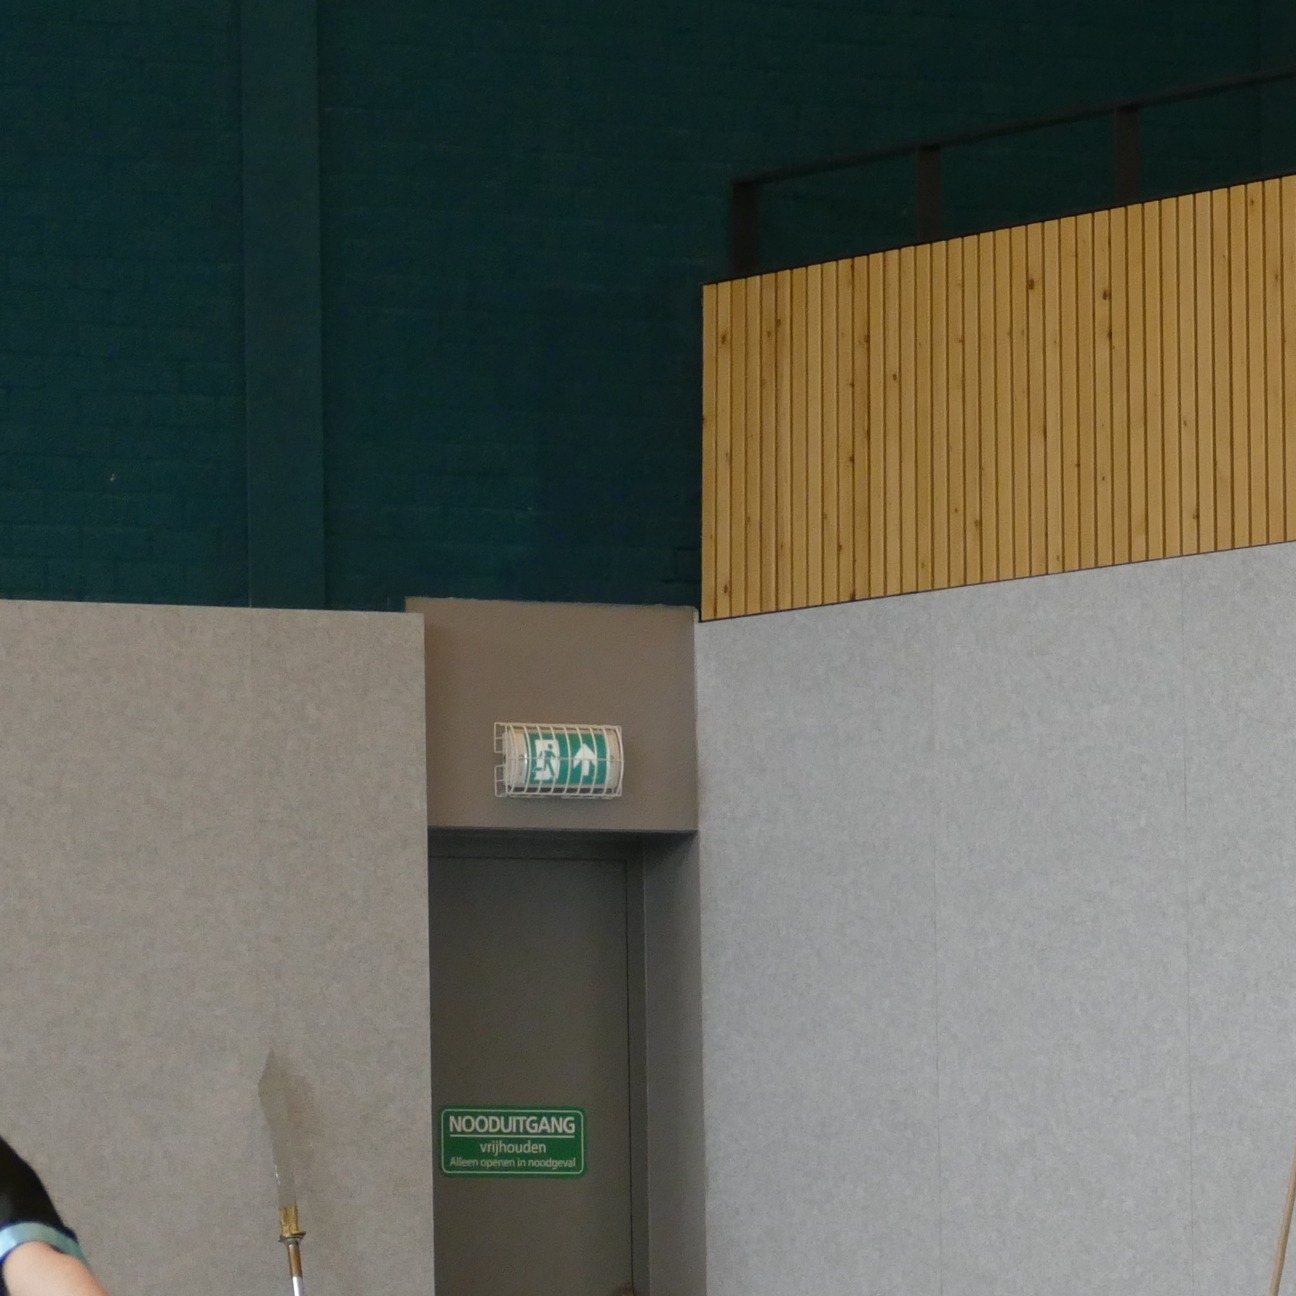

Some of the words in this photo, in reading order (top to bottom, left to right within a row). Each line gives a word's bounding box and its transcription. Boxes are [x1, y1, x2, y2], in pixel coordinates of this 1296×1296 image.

[449, 1115, 576, 1134] NOODUITGANG
[479, 1140, 547, 1156] vrijhouden
[449, 1156, 479, 1167] Alleen
[480, 1158, 516, 1168] openen
[517, 1157, 527, 1167] in
[527, 1157, 576, 1170] noodgeval
